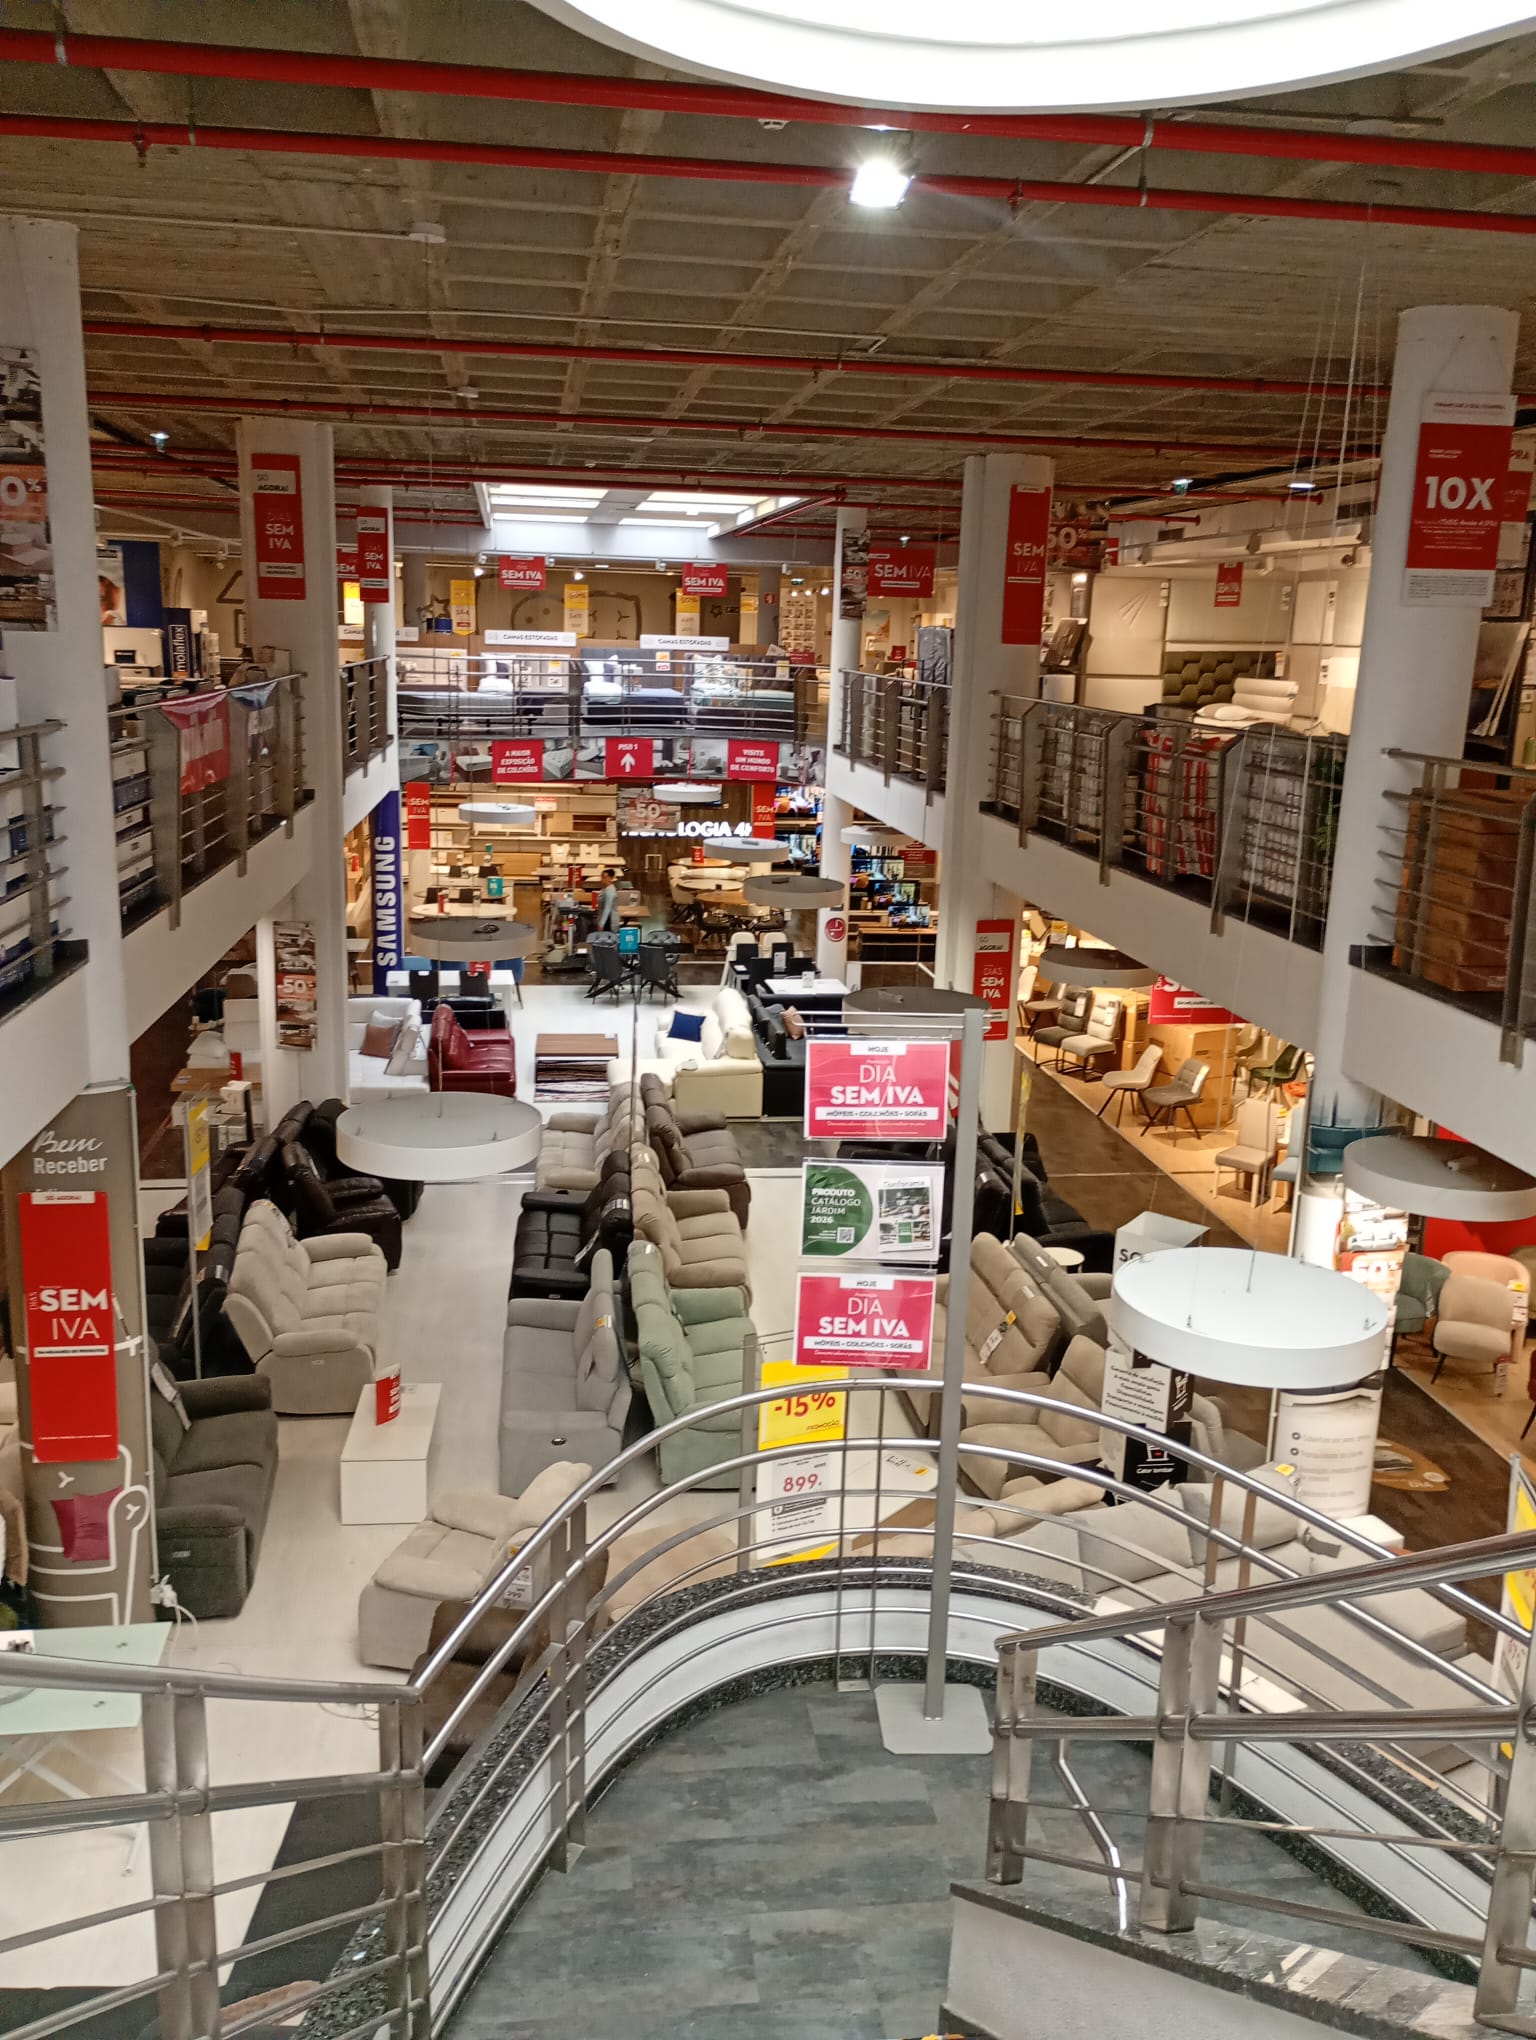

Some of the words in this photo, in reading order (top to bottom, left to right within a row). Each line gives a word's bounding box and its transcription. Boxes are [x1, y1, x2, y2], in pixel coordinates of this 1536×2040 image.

[1425, 476, 1496, 511] 10X
[265, 524, 295, 535] SEM
[269, 538, 292, 549] IVA
[1013, 543, 1044, 557] SEM
[364, 552, 384, 560] SEM
[366, 562, 382, 570] IVA
[874, 564, 907, 578] SEM
[909, 565, 932, 578] IVA
[1016, 560, 1039, 573] IVA
[502, 570, 524, 579] SEM
[525, 571, 543, 580] IVA
[685, 577, 707, 586] SEM
[708, 578, 725, 587] IVA
[172, 627, 186, 672] molaflex
[374, 836, 398, 967] SAMSUNG
[983, 967, 1003, 976] DIAS
[981, 977, 1004, 987] SEM
[982, 989, 1001, 999] IVA
[859, 1064, 897, 1083] DIA
[830, 1085, 880, 1105] SEM
[886, 1086, 924, 1105] IVA
[32, 1130, 104, 1153] Bem
[32, 1157, 108, 1175] Receber
[811, 1187, 856, 1197] PRODUTO
[811, 1196, 861, 1207] CATÁLOGO
[810, 1207, 846, 1215] JARDIM
[39, 1288, 109, 1312] SEM
[847, 1297, 884, 1316] DIA
[51, 1317, 101, 1340] IVA
[818, 1316, 867, 1336] SEM
[873, 1318, 910, 1337] IVA
[774, 1391, 836, 1418] -15%
